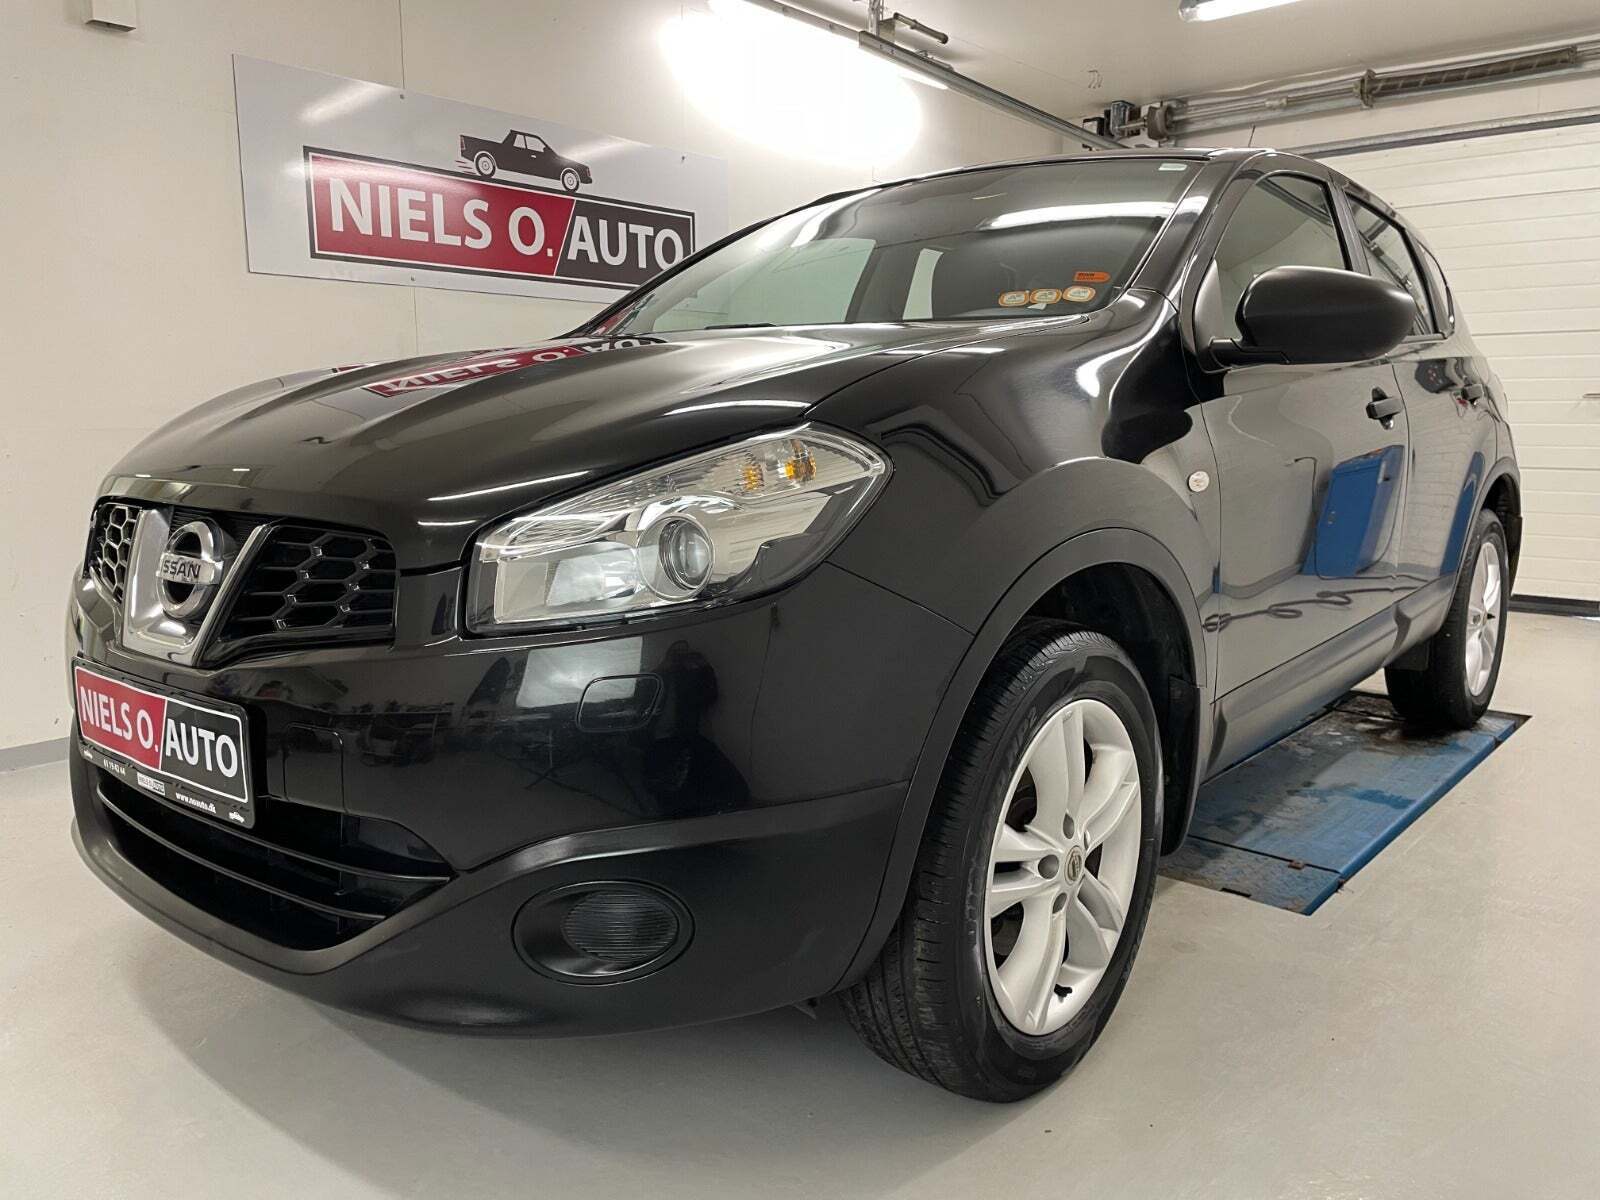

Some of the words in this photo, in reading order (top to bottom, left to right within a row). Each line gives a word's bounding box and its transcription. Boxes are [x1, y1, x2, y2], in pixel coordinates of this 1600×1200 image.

[328, 177, 493, 250] NIELS
[508, 207, 554, 257] O.
[567, 216, 683, 270] AUTO
[80, 686, 134, 741] NIELS
[136, 708, 160, 754] O.
[165, 719, 237, 778] AUTO
